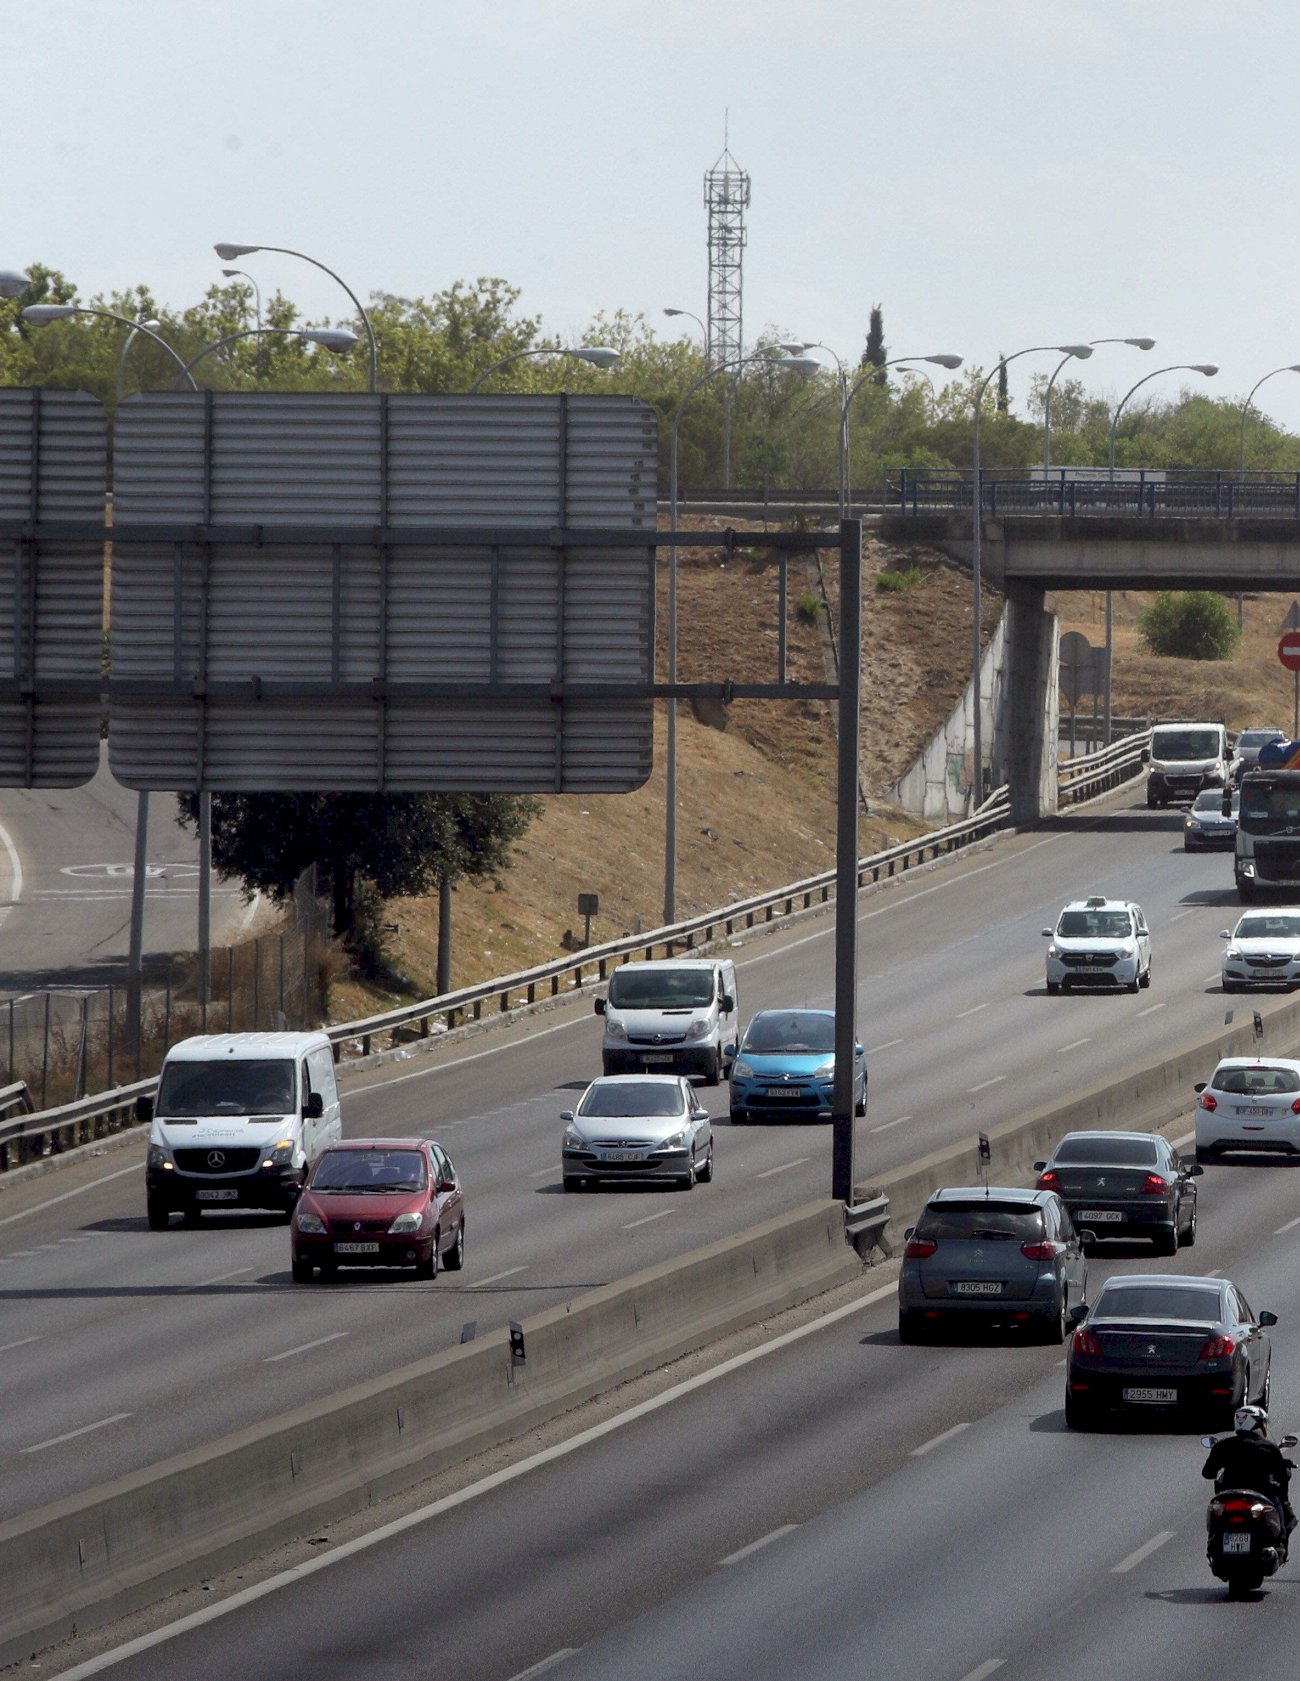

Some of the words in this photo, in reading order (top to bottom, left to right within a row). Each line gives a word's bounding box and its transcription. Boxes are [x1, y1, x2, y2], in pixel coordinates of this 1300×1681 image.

[1084, 1212, 1102, 1220] 4097
[960, 1283, 981, 1292] 8305
[982, 1283, 1000, 1292] HGZ
[1130, 1389, 1153, 1399] 2955
[1156, 1390, 1174, 1400] HMY
